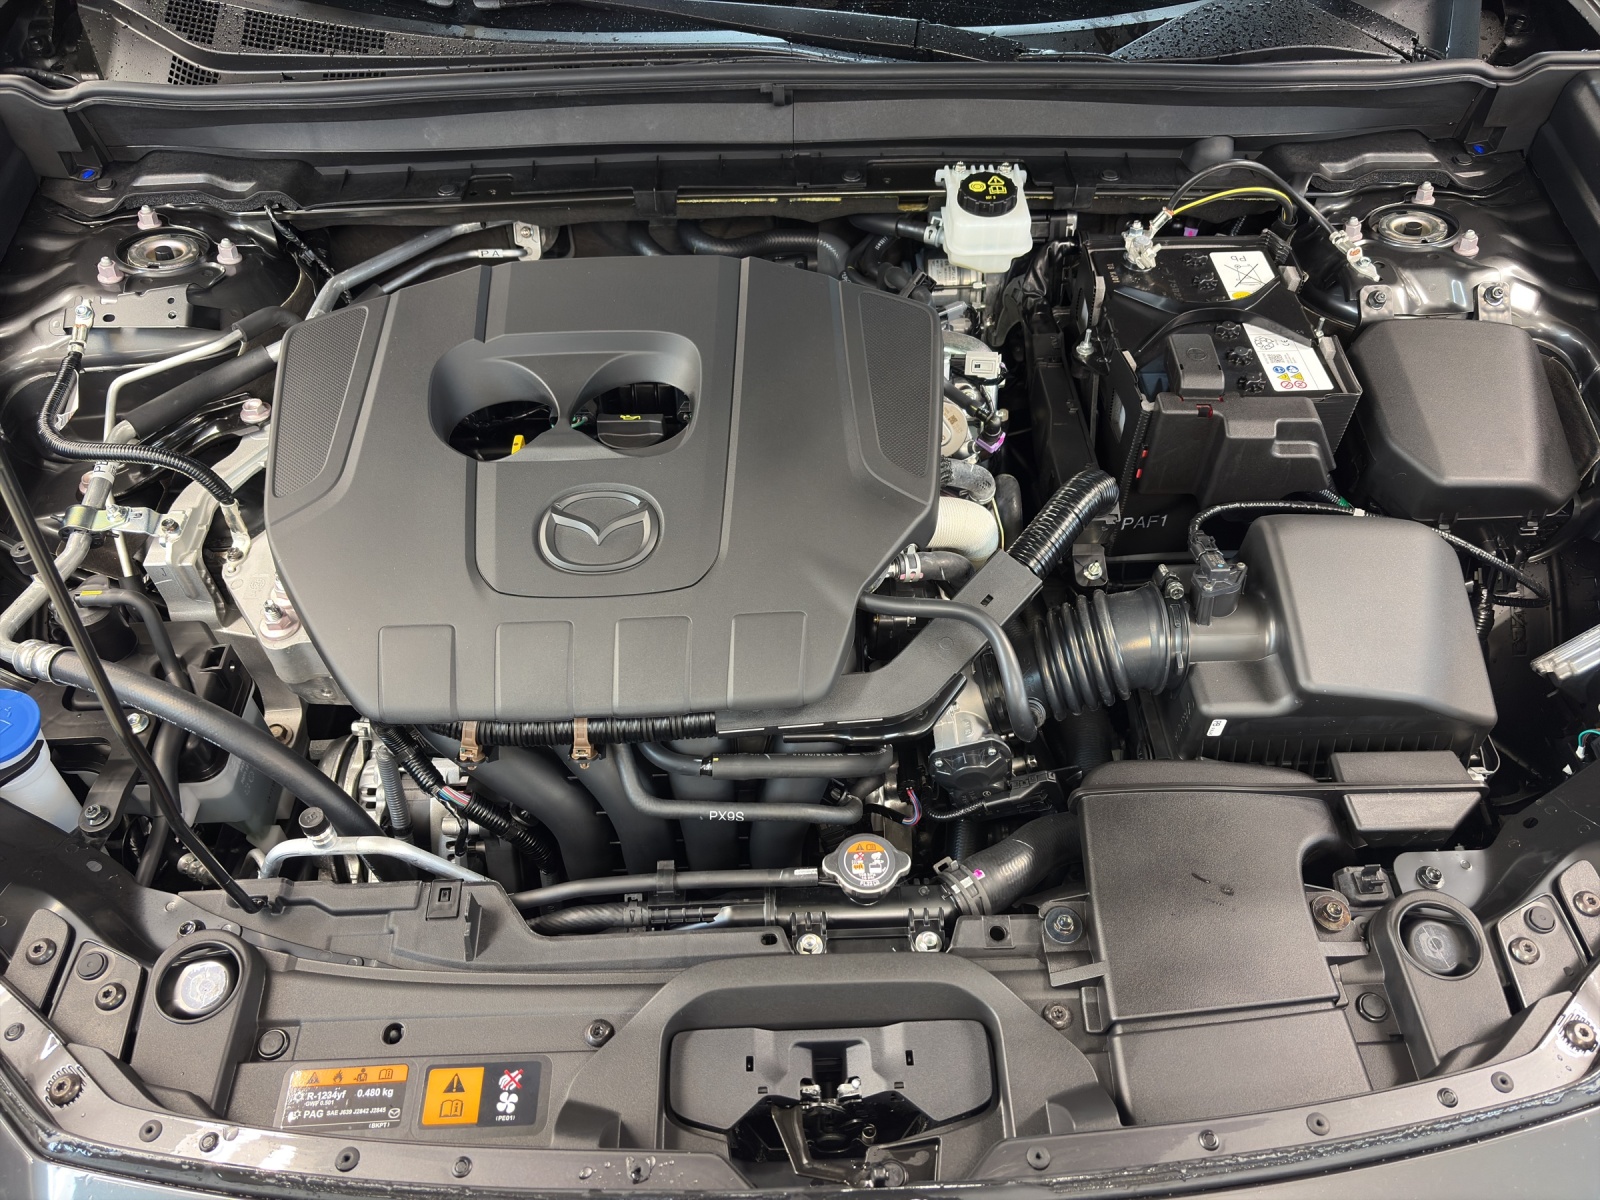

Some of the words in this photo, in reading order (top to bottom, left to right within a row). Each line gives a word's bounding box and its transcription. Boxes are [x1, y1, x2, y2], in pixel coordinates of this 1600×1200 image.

[1120, 514, 1168, 530] PAF1
[710, 810, 744, 821] PX9S
[307, 1090, 346, 1100] R-1234yf
[357, 1088, 380, 1098] 0.480
[382, 1088, 394, 1097] kg
[304, 1110, 324, 1118] PAG
